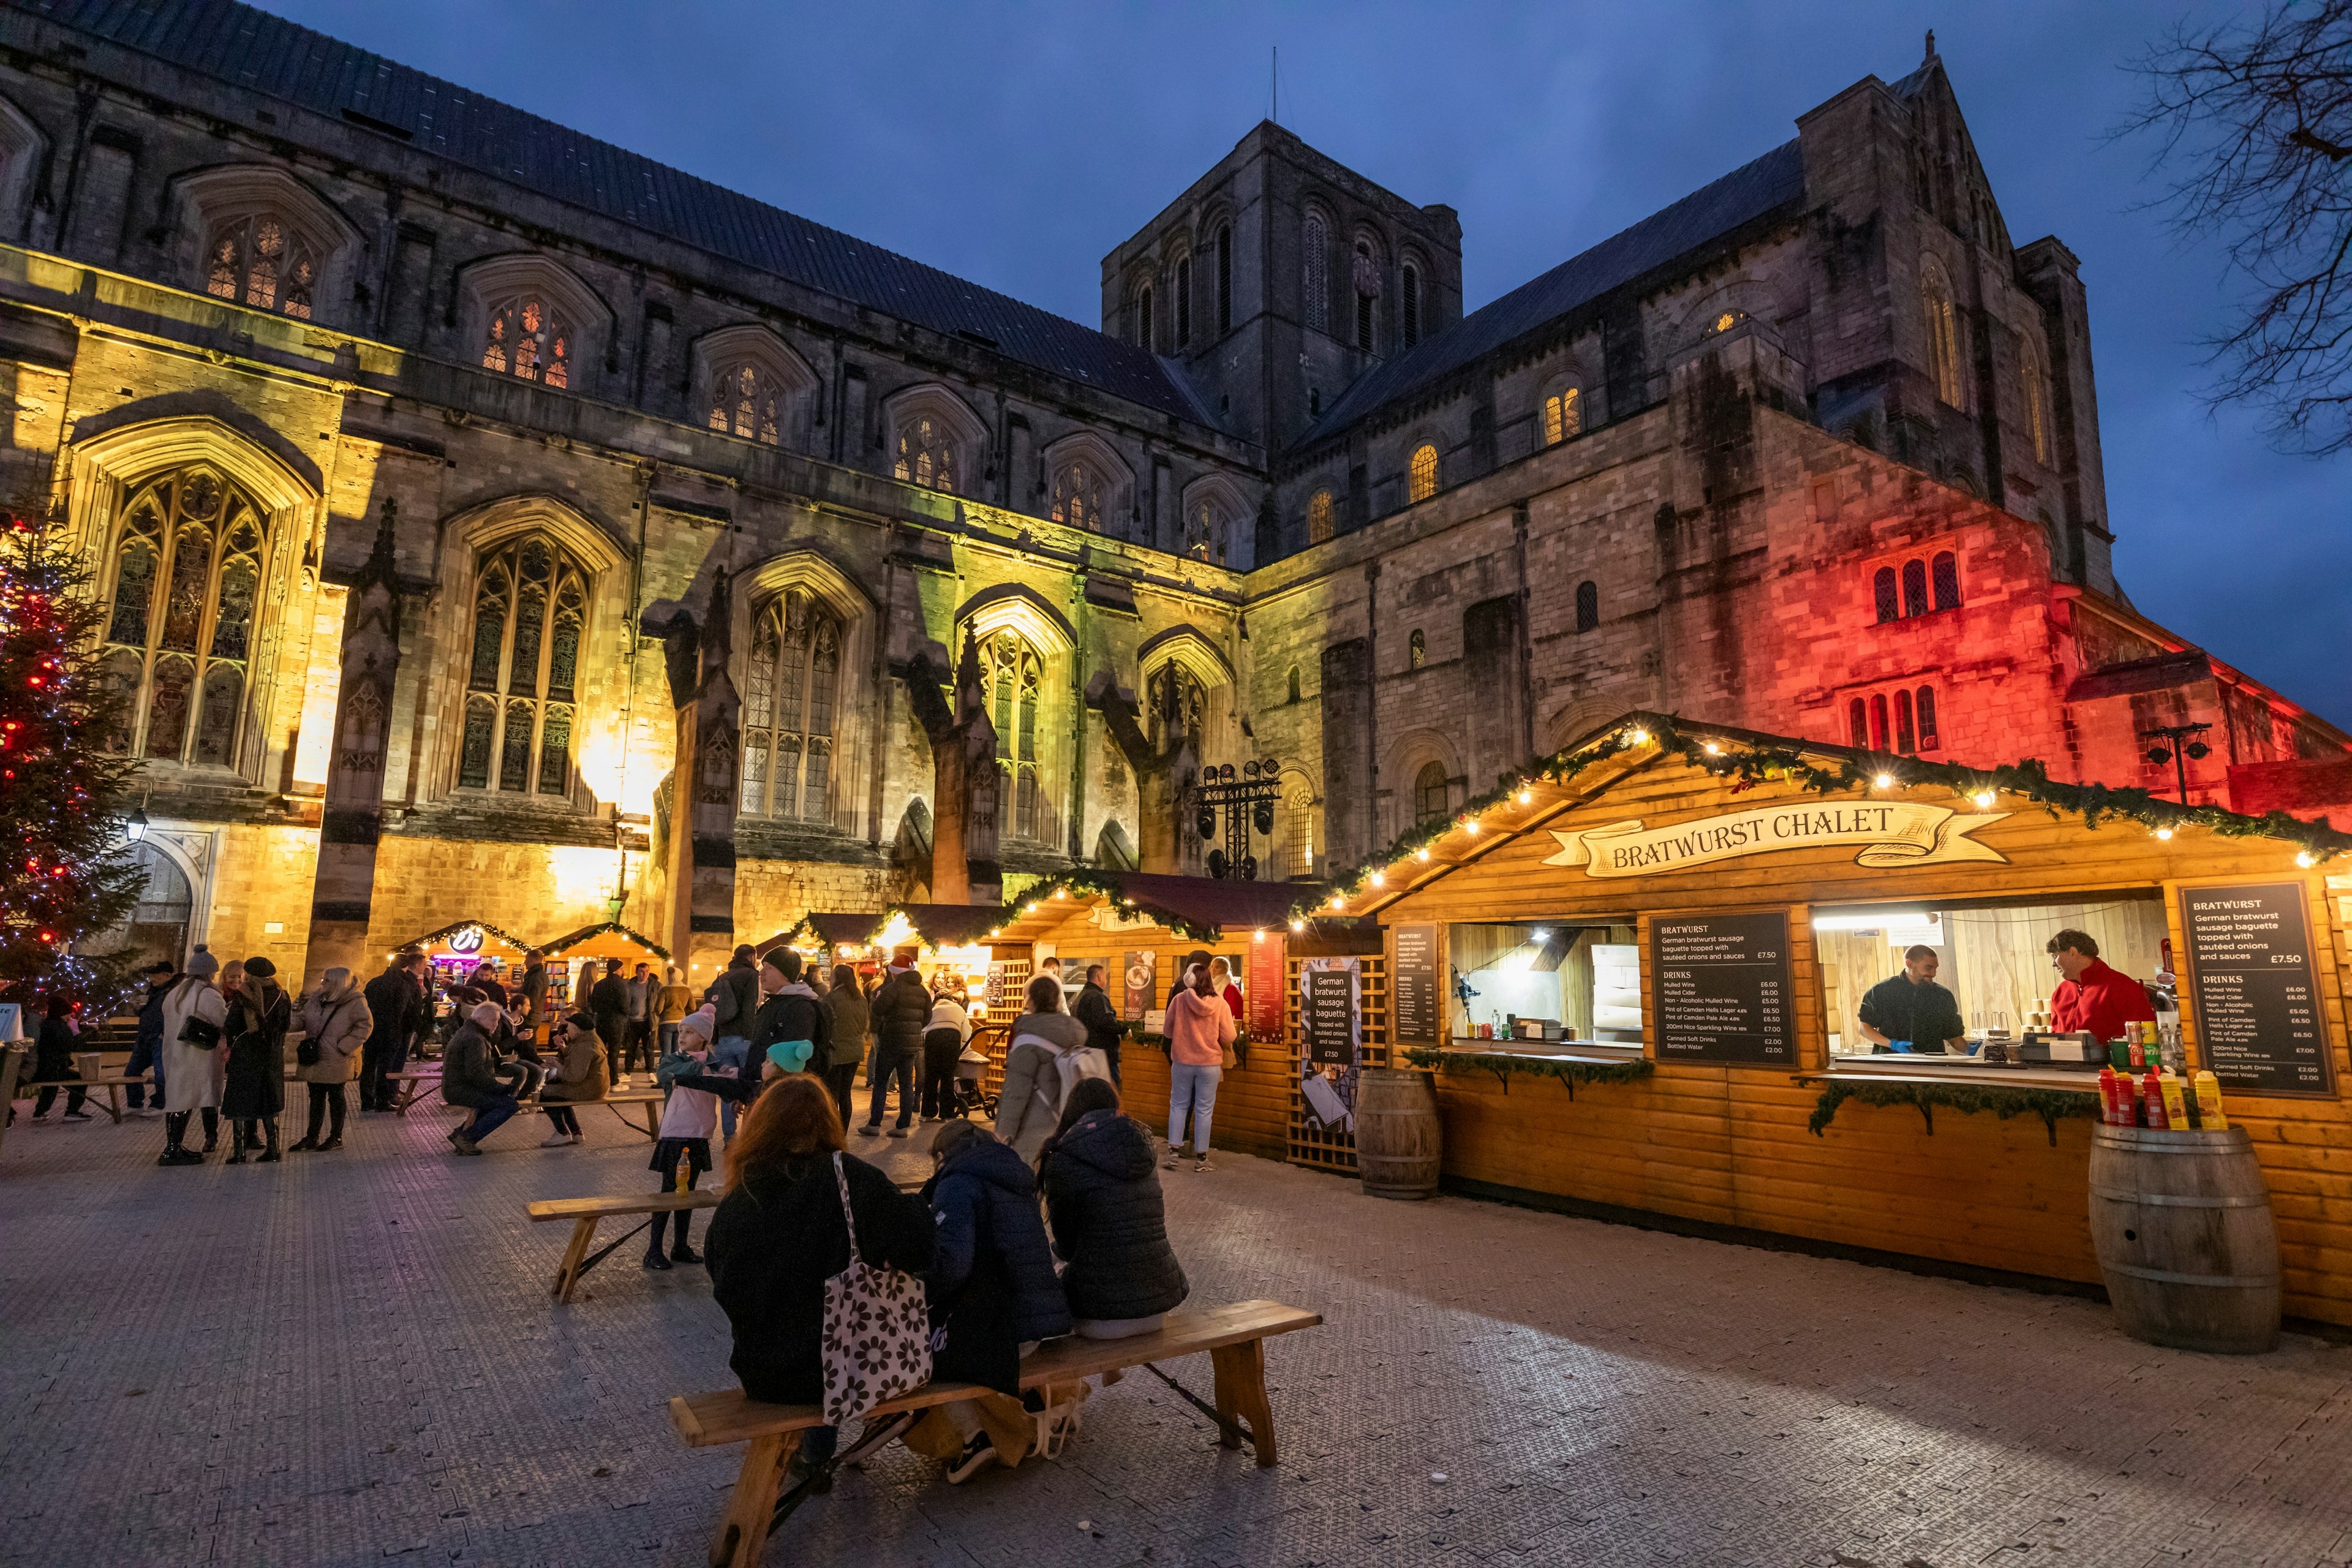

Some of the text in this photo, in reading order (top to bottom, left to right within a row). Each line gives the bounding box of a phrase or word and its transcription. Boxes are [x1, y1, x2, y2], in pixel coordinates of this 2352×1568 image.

[1613, 808, 1894, 869] BRATWURST CHALET
[2193, 900, 2262, 910] BRATWURST
[2233, 912, 2279, 921] bratwurst
[1661, 925, 1709, 934] BRATWURST
[2271, 955, 2301, 963] £7.50
[1314, 987, 1347, 996] bratwurst
[1316, 1009, 1346, 1019] baguette
